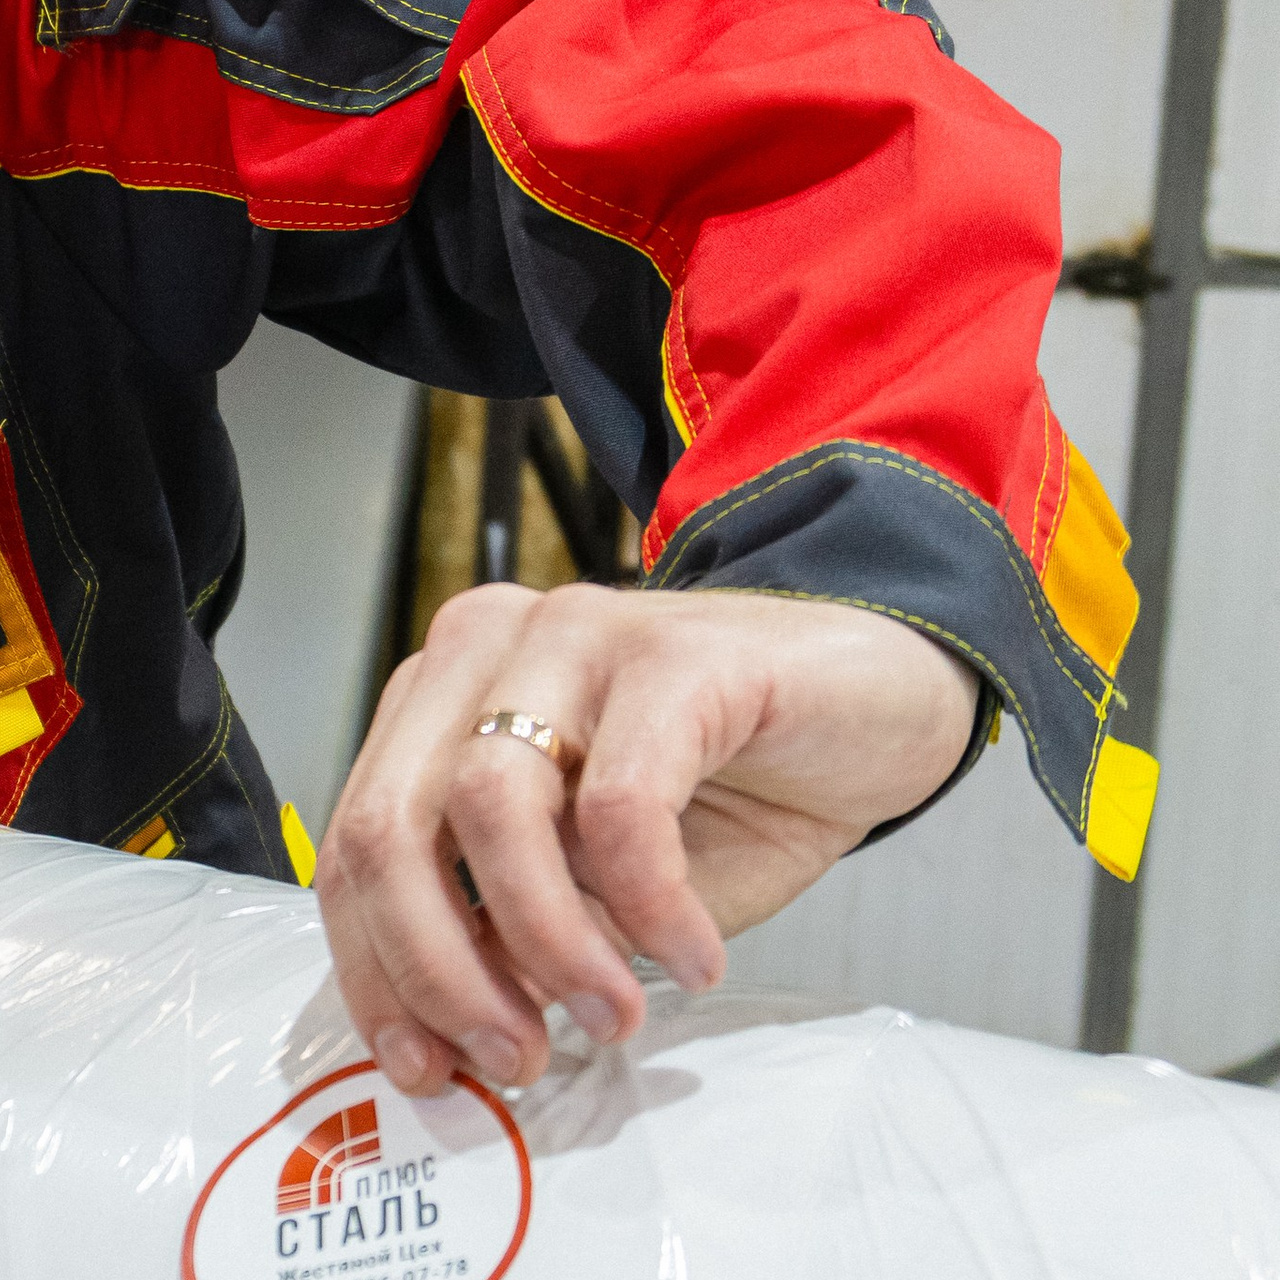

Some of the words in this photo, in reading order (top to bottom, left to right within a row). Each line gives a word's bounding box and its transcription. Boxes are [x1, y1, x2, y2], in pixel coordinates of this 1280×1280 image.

[356, 1155, 437, 1200] ПЛЮС
[277, 1189, 439, 1258] СТАЛЬ
[399, 1241, 442, 1262] Цех
